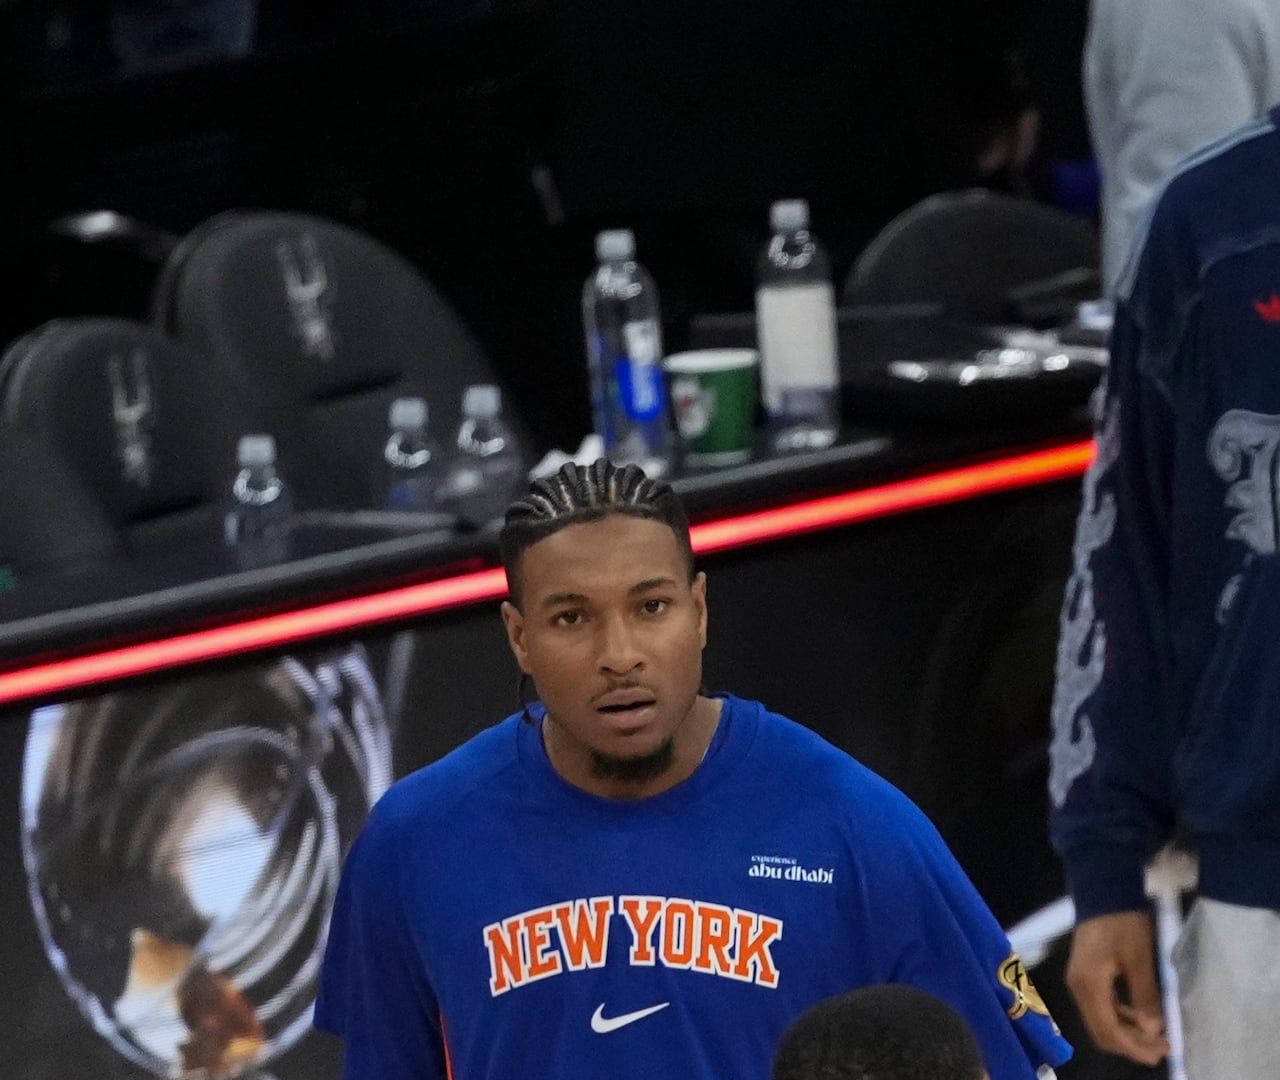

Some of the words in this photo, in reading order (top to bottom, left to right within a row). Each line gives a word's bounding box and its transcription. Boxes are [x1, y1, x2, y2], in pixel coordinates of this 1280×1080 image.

[748, 863, 782, 879] abu
[784, 866, 835, 884] dhabi
[483, 895, 614, 998] NEW
[618, 895, 783, 990] YORK
